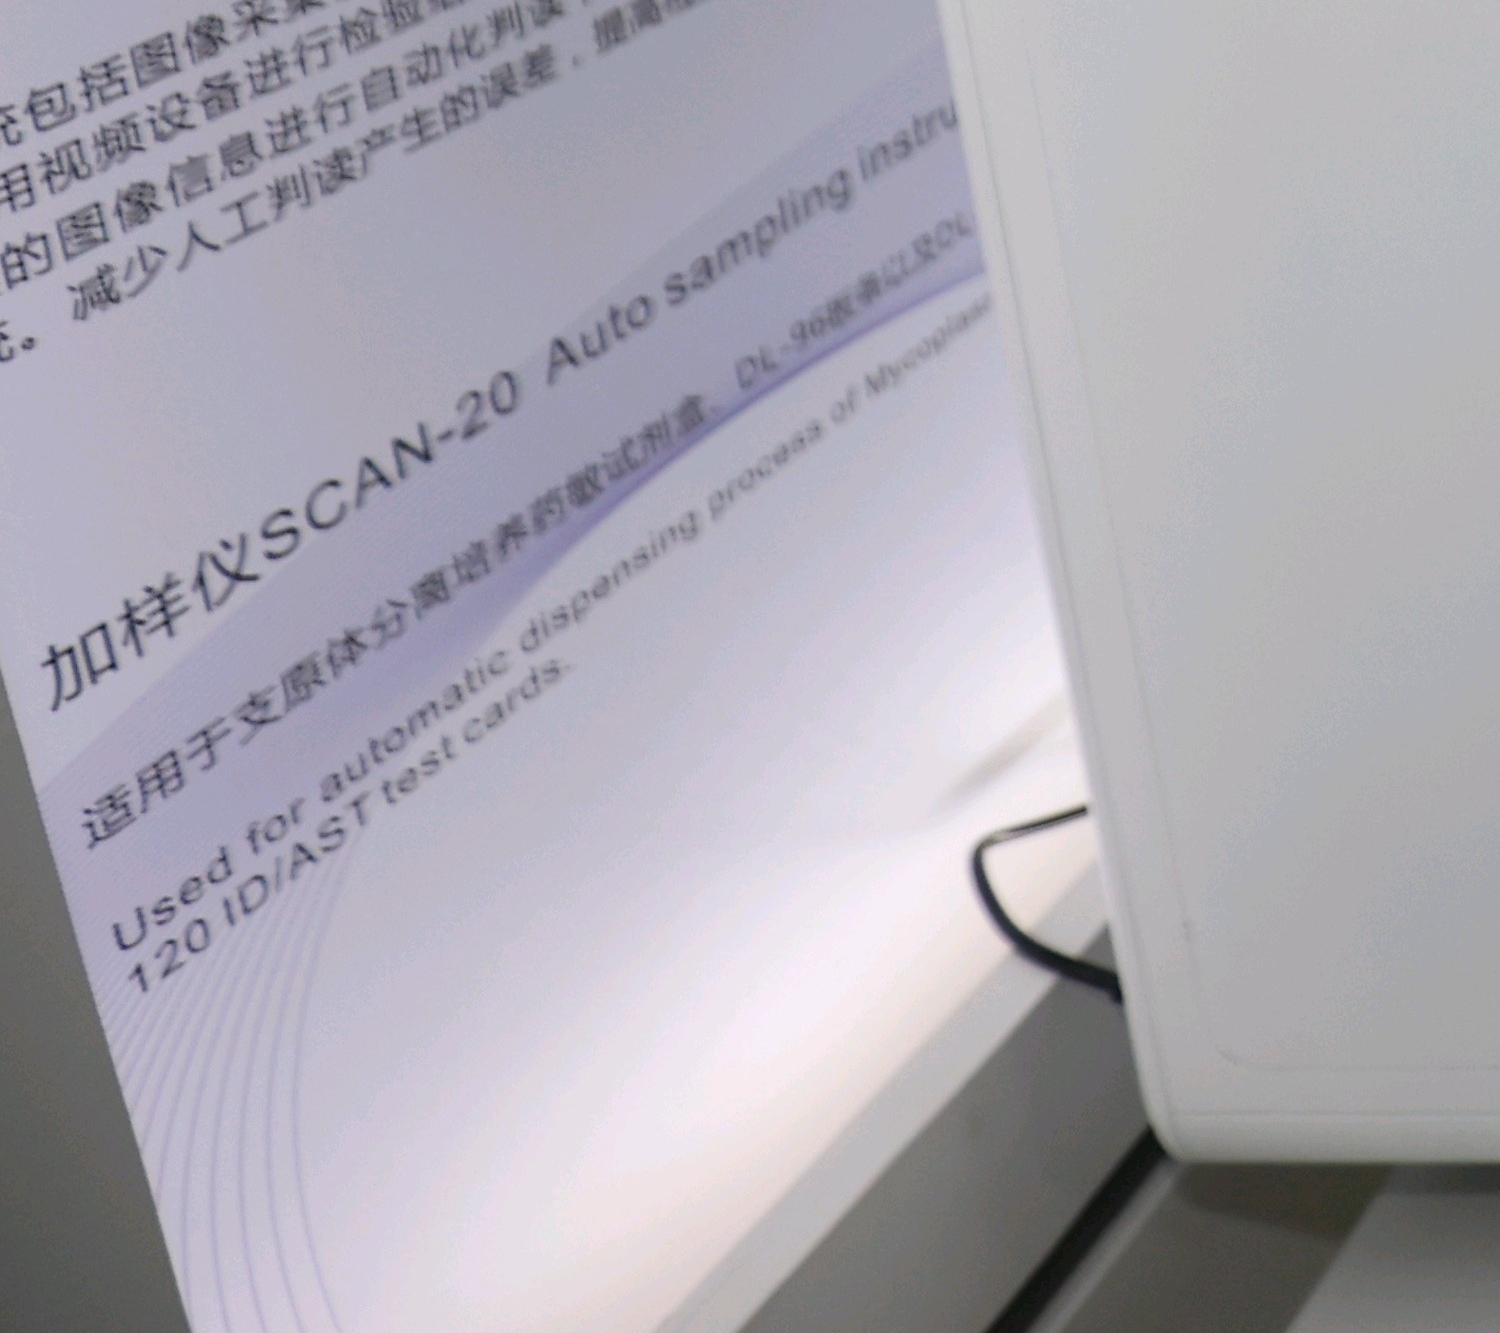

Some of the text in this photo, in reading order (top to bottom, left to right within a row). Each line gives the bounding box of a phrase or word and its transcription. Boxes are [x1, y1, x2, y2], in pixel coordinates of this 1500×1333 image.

[546, 294, 656, 387] Auto
[663, 169, 853, 308] sampling
[111, 847, 234, 956] Used
[246, 796, 305, 861] for
[318, 644, 510, 808] automatic
[519, 509, 701, 652] dispensing
[707, 416, 824, 521] process
[127, 919, 212, 997] 120
[220, 788, 376, 935] ID/AST
[384, 738, 458, 808] test
